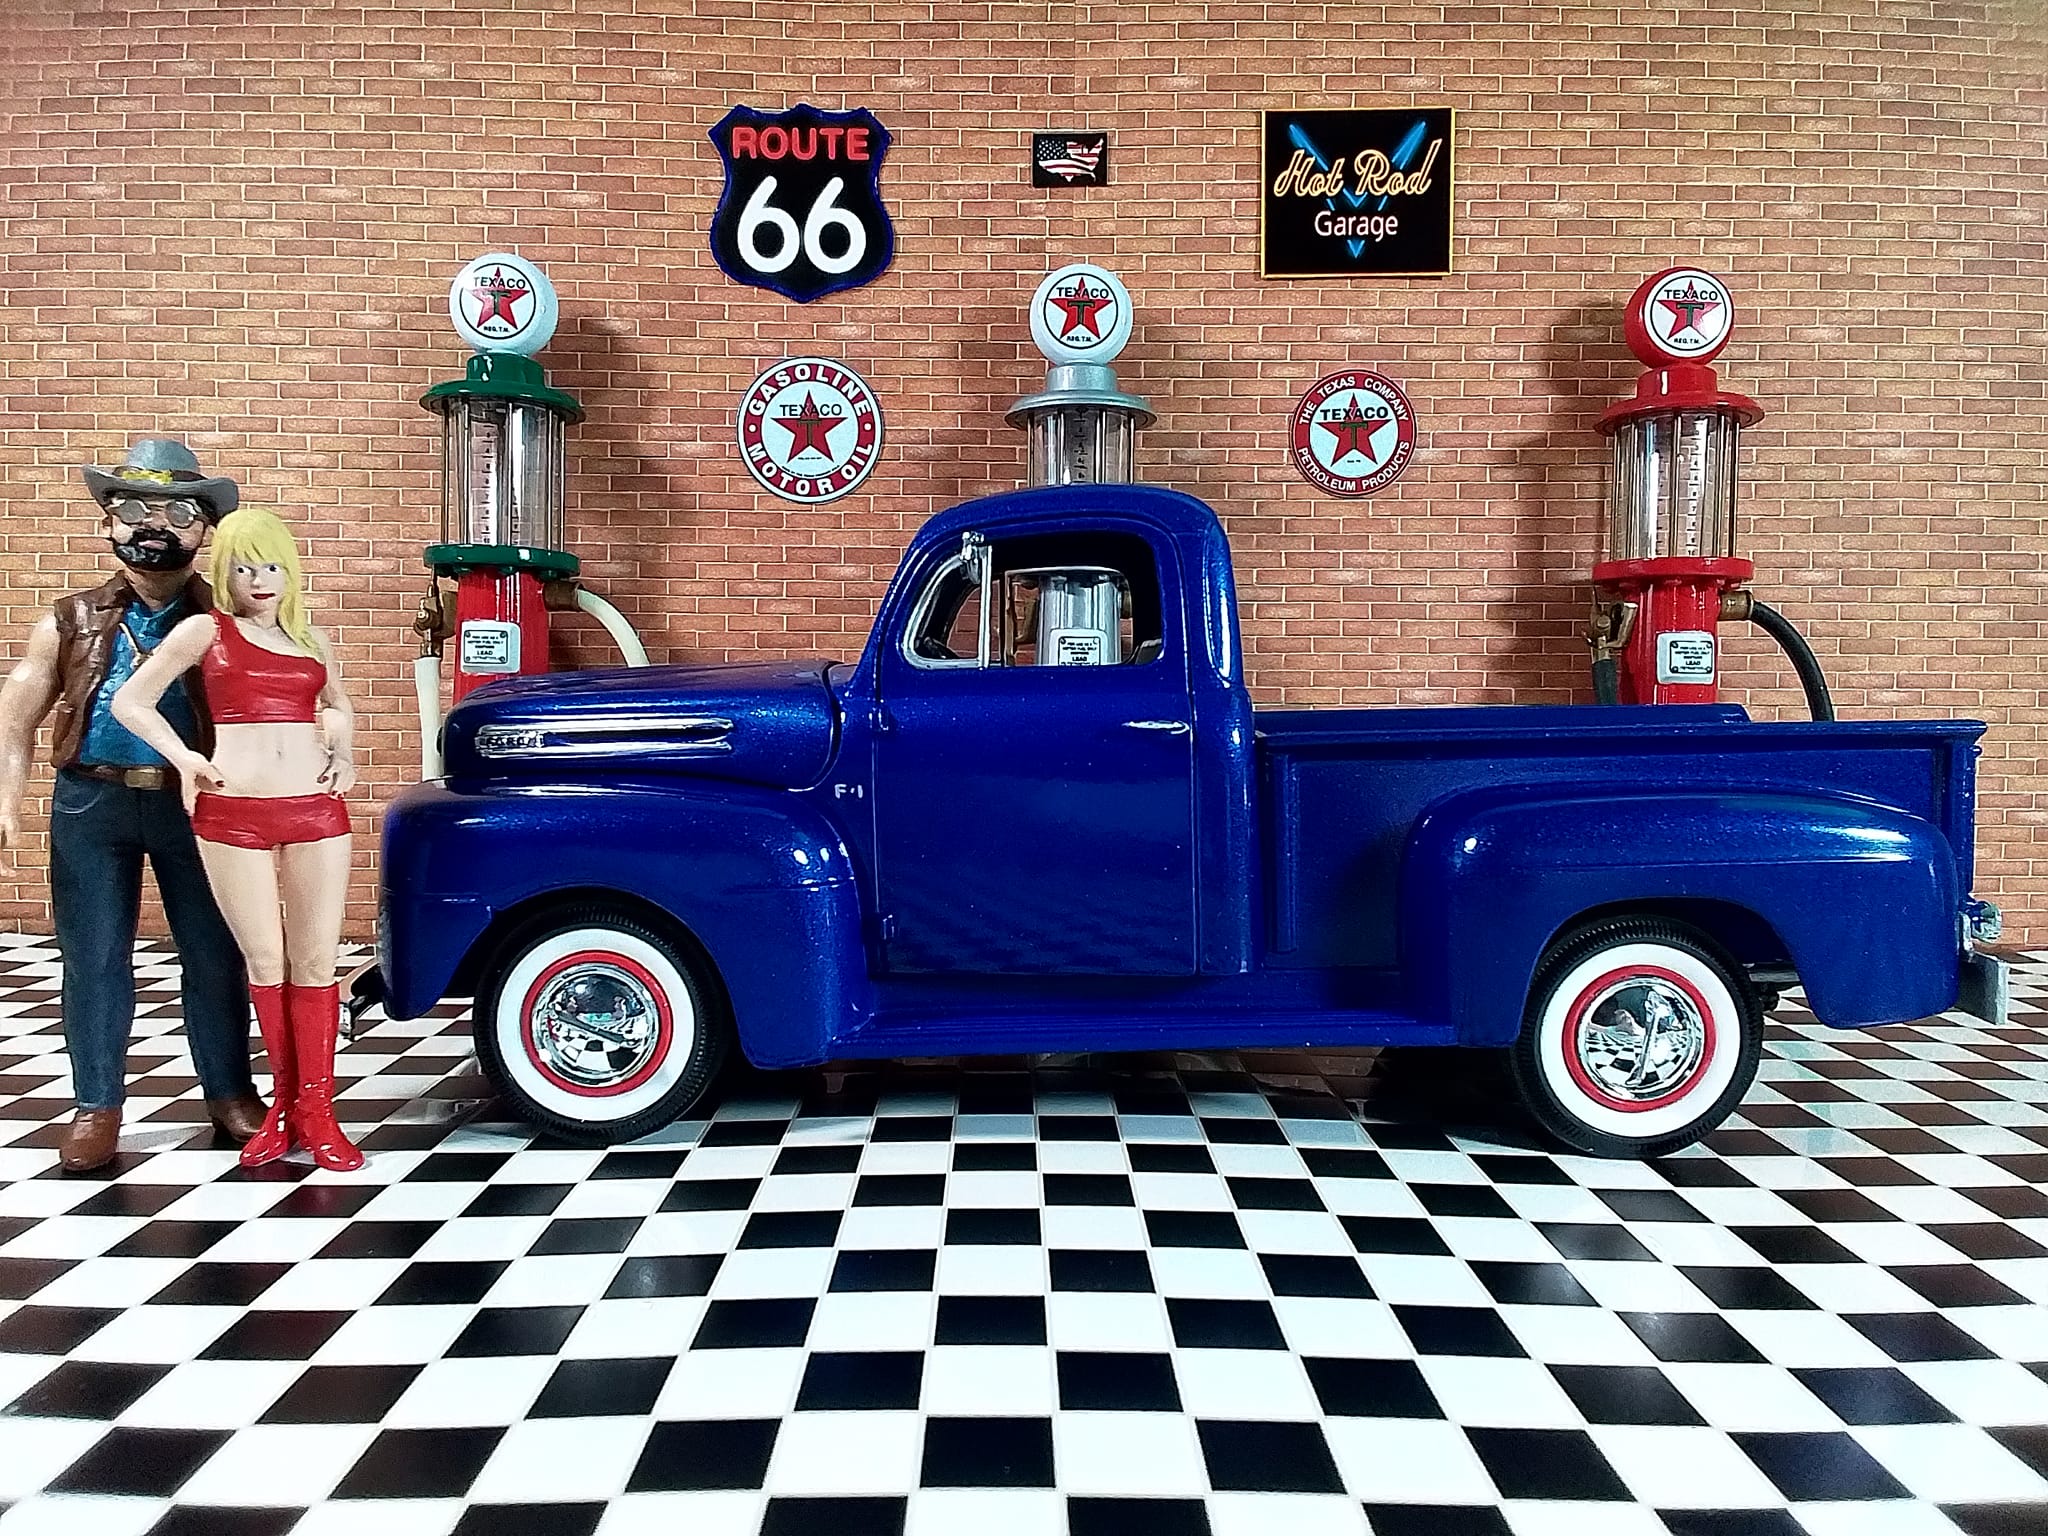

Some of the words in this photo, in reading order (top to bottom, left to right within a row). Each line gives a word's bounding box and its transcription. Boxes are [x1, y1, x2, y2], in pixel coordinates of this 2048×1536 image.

[732, 126, 870, 161] ROUTE
[1273, 149, 1346, 197] Hot
[1354, 138, 1443, 196] Rod
[737, 175, 867, 274] 66
[1314, 210, 1399, 242] Garage
[473, 277, 526, 289] TEXACO
[1056, 287, 1109, 299] TEXACO
[1664, 289, 1718, 301] TEXACO
[1067, 300, 1096, 325] T
[1676, 302, 1705, 327] T
[748, 364, 872, 417] GASOLINE
[1299, 401, 1317, 425] THE
[1316, 376, 1356, 398] TEXAS
[1364, 378, 1409, 421] COMPANY
[779, 403, 843, 417] TEXACO
[1320, 406, 1389, 421] TEXACO
[747, 442, 835, 496] MOTOR
[840, 444, 873, 480] OIL
[1298, 447, 1356, 491] PETROLEUM
[1361, 441, 1410, 490] PRODUCTS
[834, 783, 864, 799] F-1
